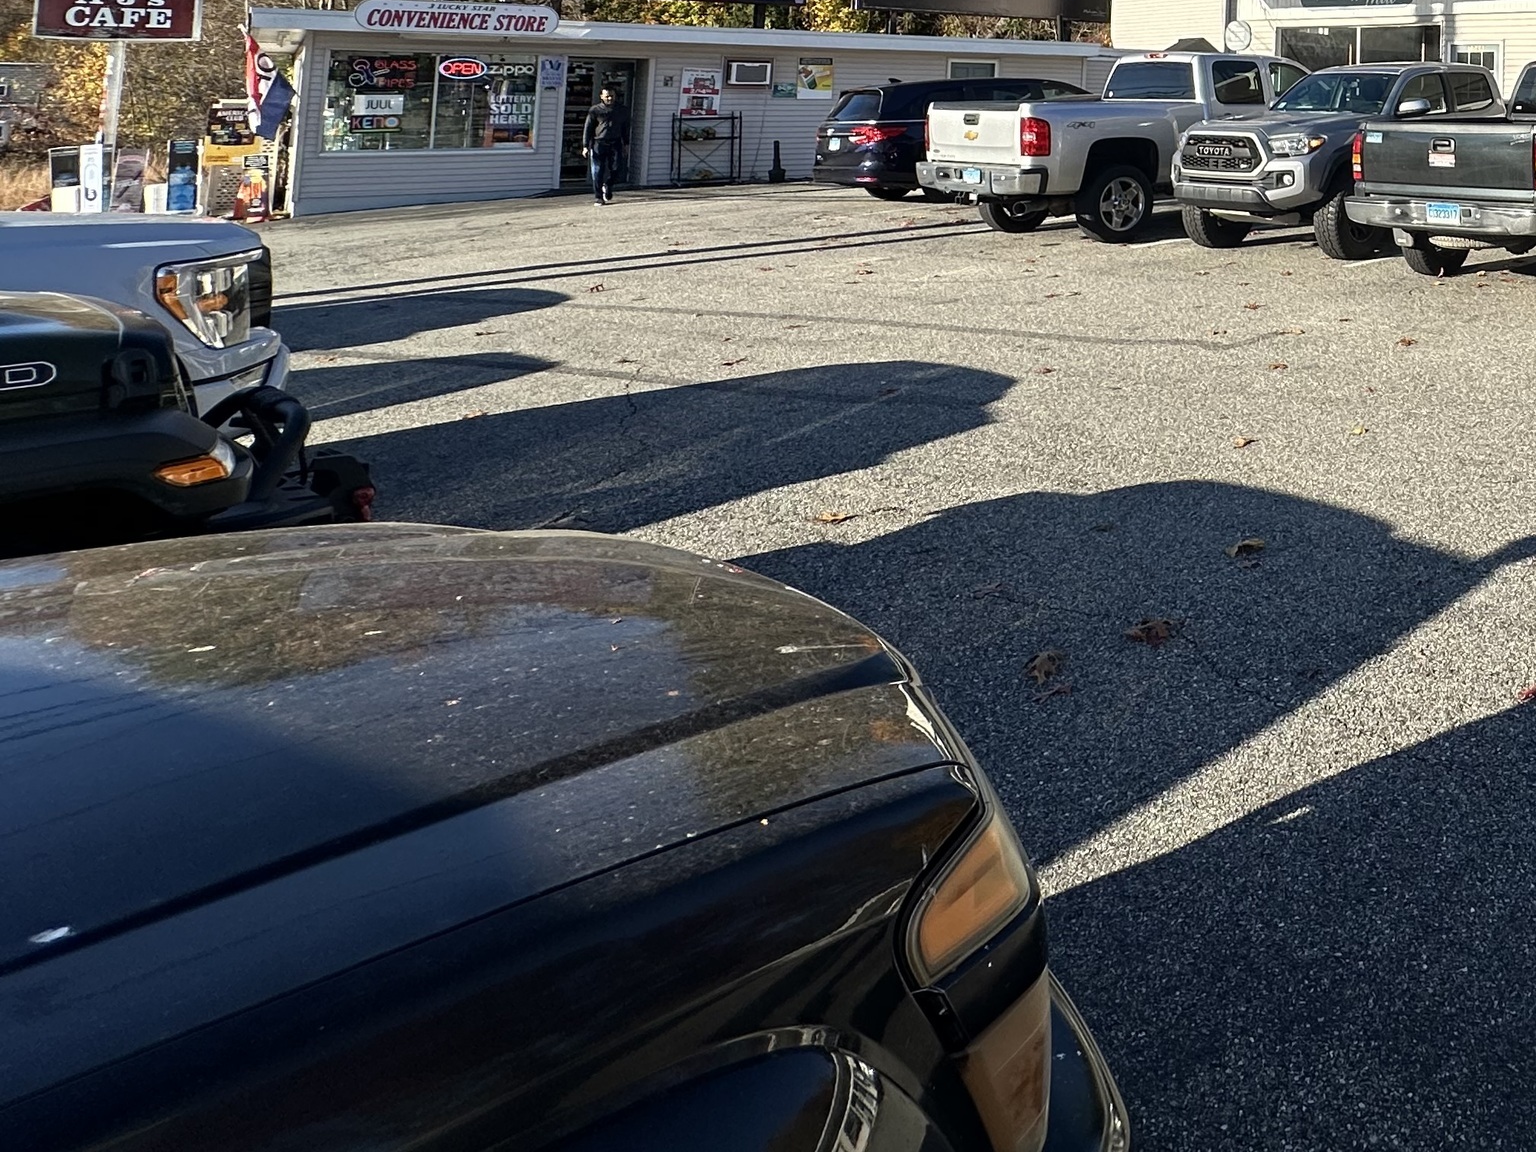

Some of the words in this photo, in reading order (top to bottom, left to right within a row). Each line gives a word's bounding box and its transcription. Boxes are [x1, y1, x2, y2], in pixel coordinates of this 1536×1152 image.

[436, 3, 469, 11] LUCKY
[65, 6, 172, 29] CAFE
[366, 9, 492, 32] CONVENIENCE
[493, 15, 549, 33] STORE
[374, 60, 417, 70] GLASS
[444, 62, 483, 74] OPEN
[377, 78, 415, 88] PIPES
[490, 94, 533, 103] LOTTERY
[365, 99, 393, 110] JUUL
[490, 103, 532, 114] SOLD
[490, 114, 532, 125] HERE!
[1199, 146, 1230, 156] TOYOTA
